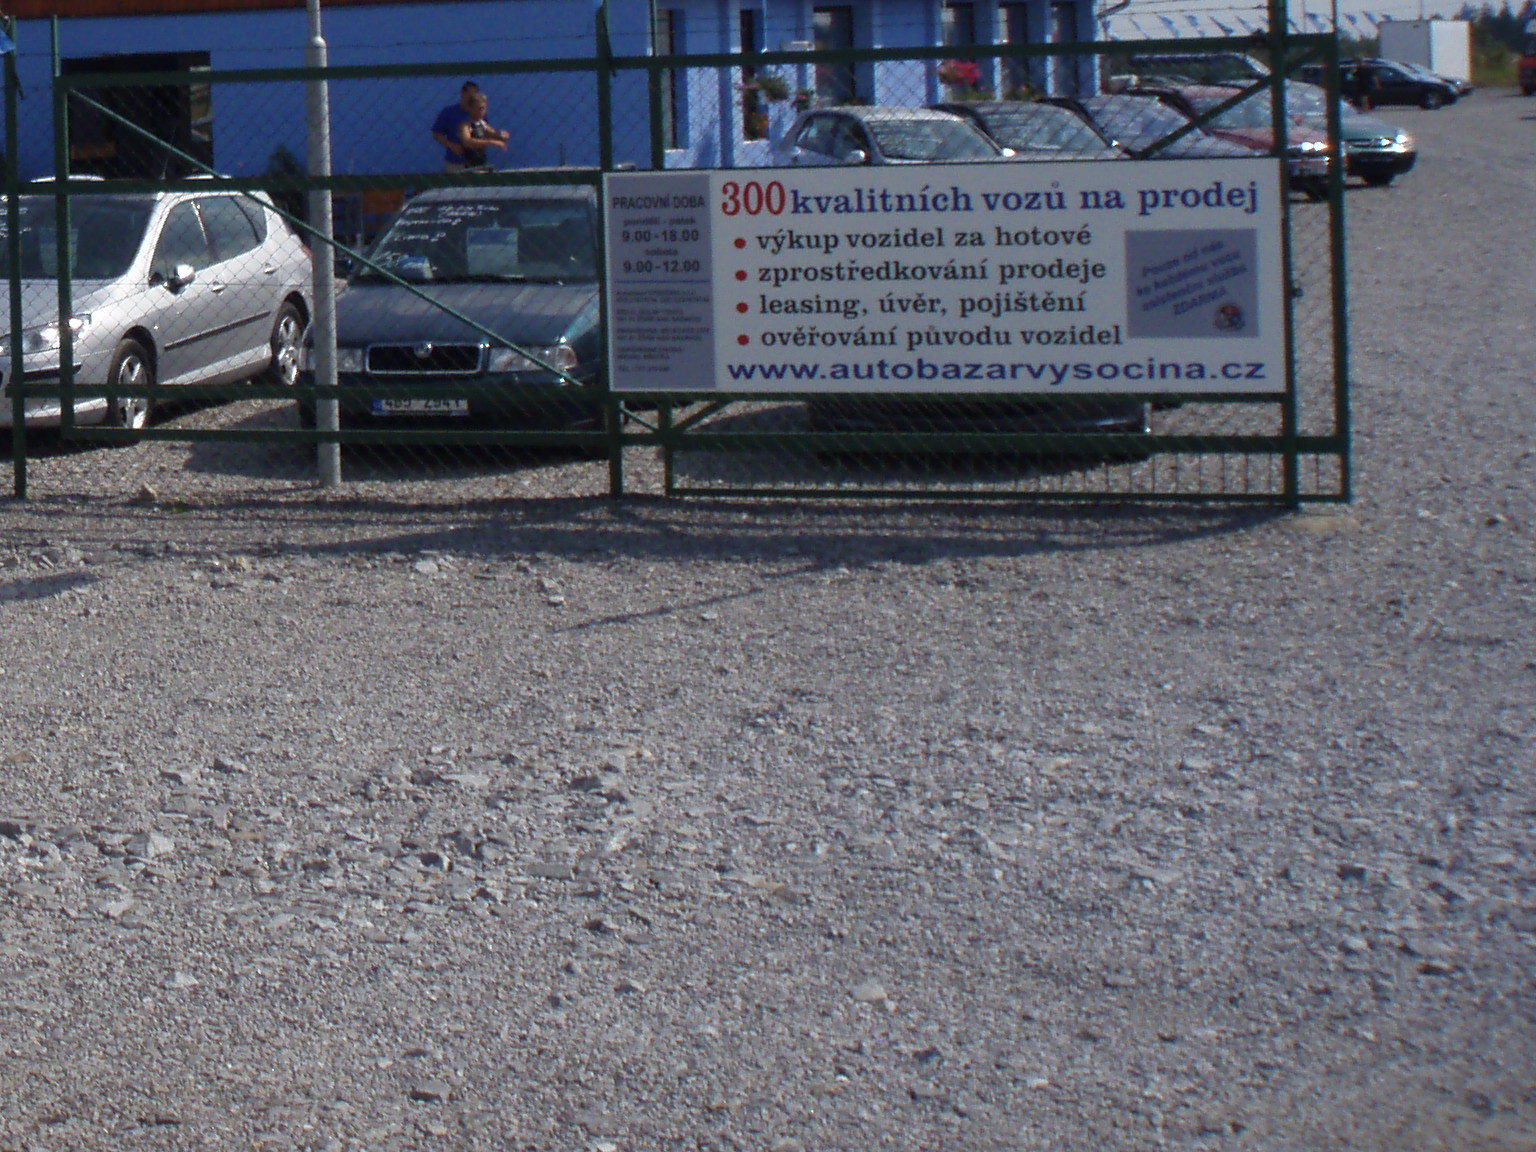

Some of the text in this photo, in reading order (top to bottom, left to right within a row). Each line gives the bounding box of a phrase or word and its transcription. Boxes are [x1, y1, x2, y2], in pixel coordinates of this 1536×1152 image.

[612, 193, 706, 209] PRACOVNÍ DOBA
[721, 181, 1258, 216] 300 kvalitních vozů na prodej
[755, 223, 1093, 255] výkup vozidel za hotové
[758, 258, 1107, 287] zprostředkování prodeje
[759, 290, 1087, 320] leasing, úvěr, pojištění
[760, 323, 1124, 352] ověřování původu vozidel
[727, 357, 1267, 386] www.autobazarvysocina.cz
